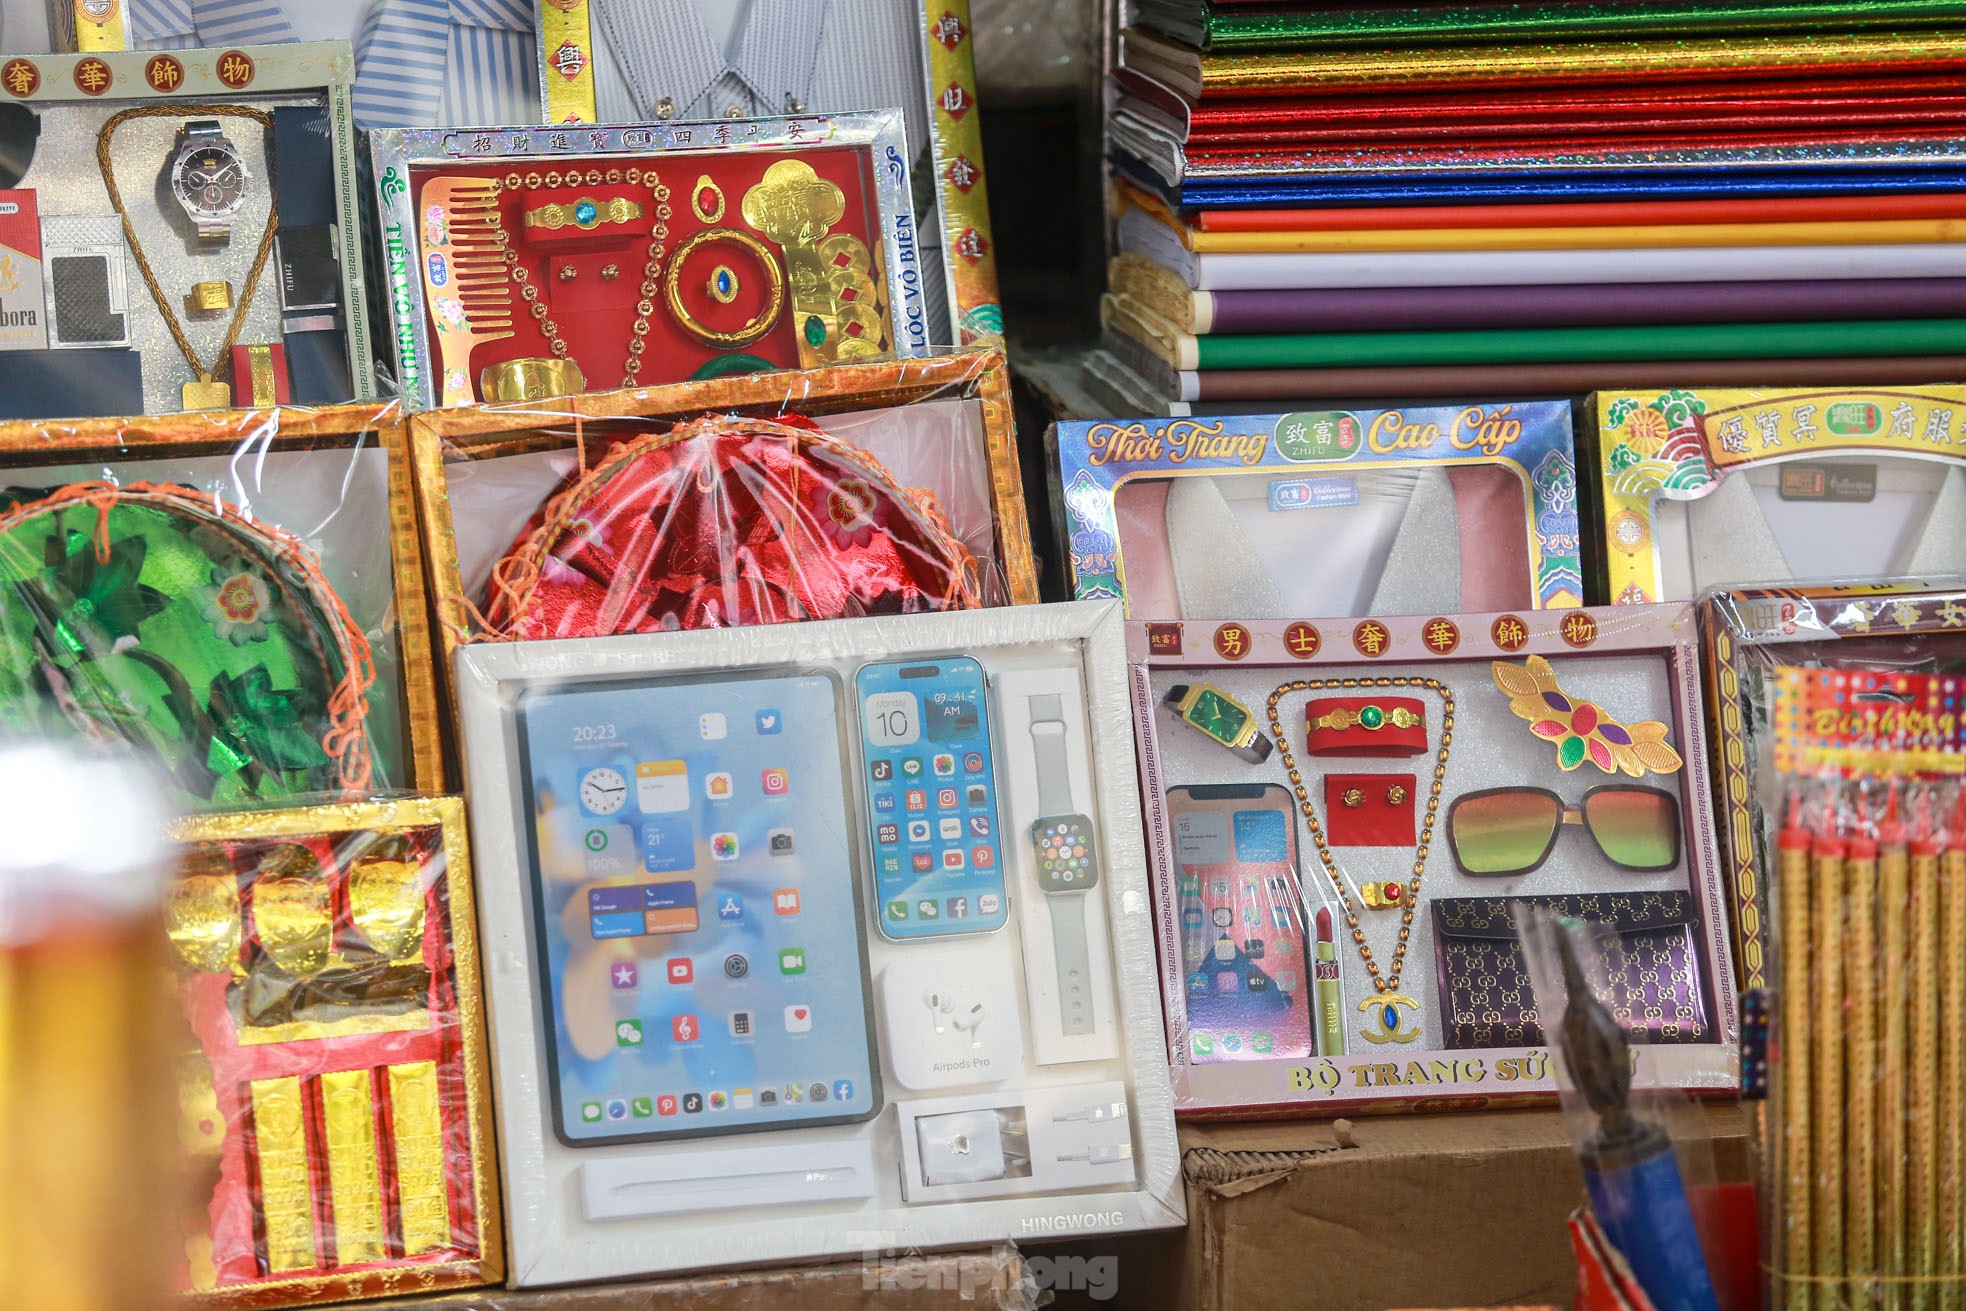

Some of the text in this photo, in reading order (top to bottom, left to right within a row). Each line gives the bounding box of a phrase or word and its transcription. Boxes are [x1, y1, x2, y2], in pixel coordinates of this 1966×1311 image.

[6, 56, 250, 93] 奢華飾物
[893, 214, 916, 264] BIÊN
[285, 263, 294, 291] ZHIFU
[897, 273, 918, 301] VÔ
[1166, 420, 1268, 466] Trang
[1285, 420, 1334, 446] 致富
[1368, 410, 1442, 455] Cao
[1450, 405, 1521, 456] Cấp
[1292, 446, 1326, 456] ZHIFU
[1221, 616, 1594, 656] 男士奢華飾物
[876, 710, 908, 738] 10
[944, 706, 961, 717] AM
[573, 724, 617, 742] 20:23
[877, 798, 893, 808] TIKI
[1179, 822, 1190, 832] 15
[588, 858, 621, 871] 100%
[982, 899, 997, 907] Zalo
[933, 1057, 990, 1072] Airpods Pro
[1288, 1059, 1341, 1096] BỘ
[1348, 1058, 1488, 1090] TRANG
[1021, 1211, 1124, 1233] HINGWONG
